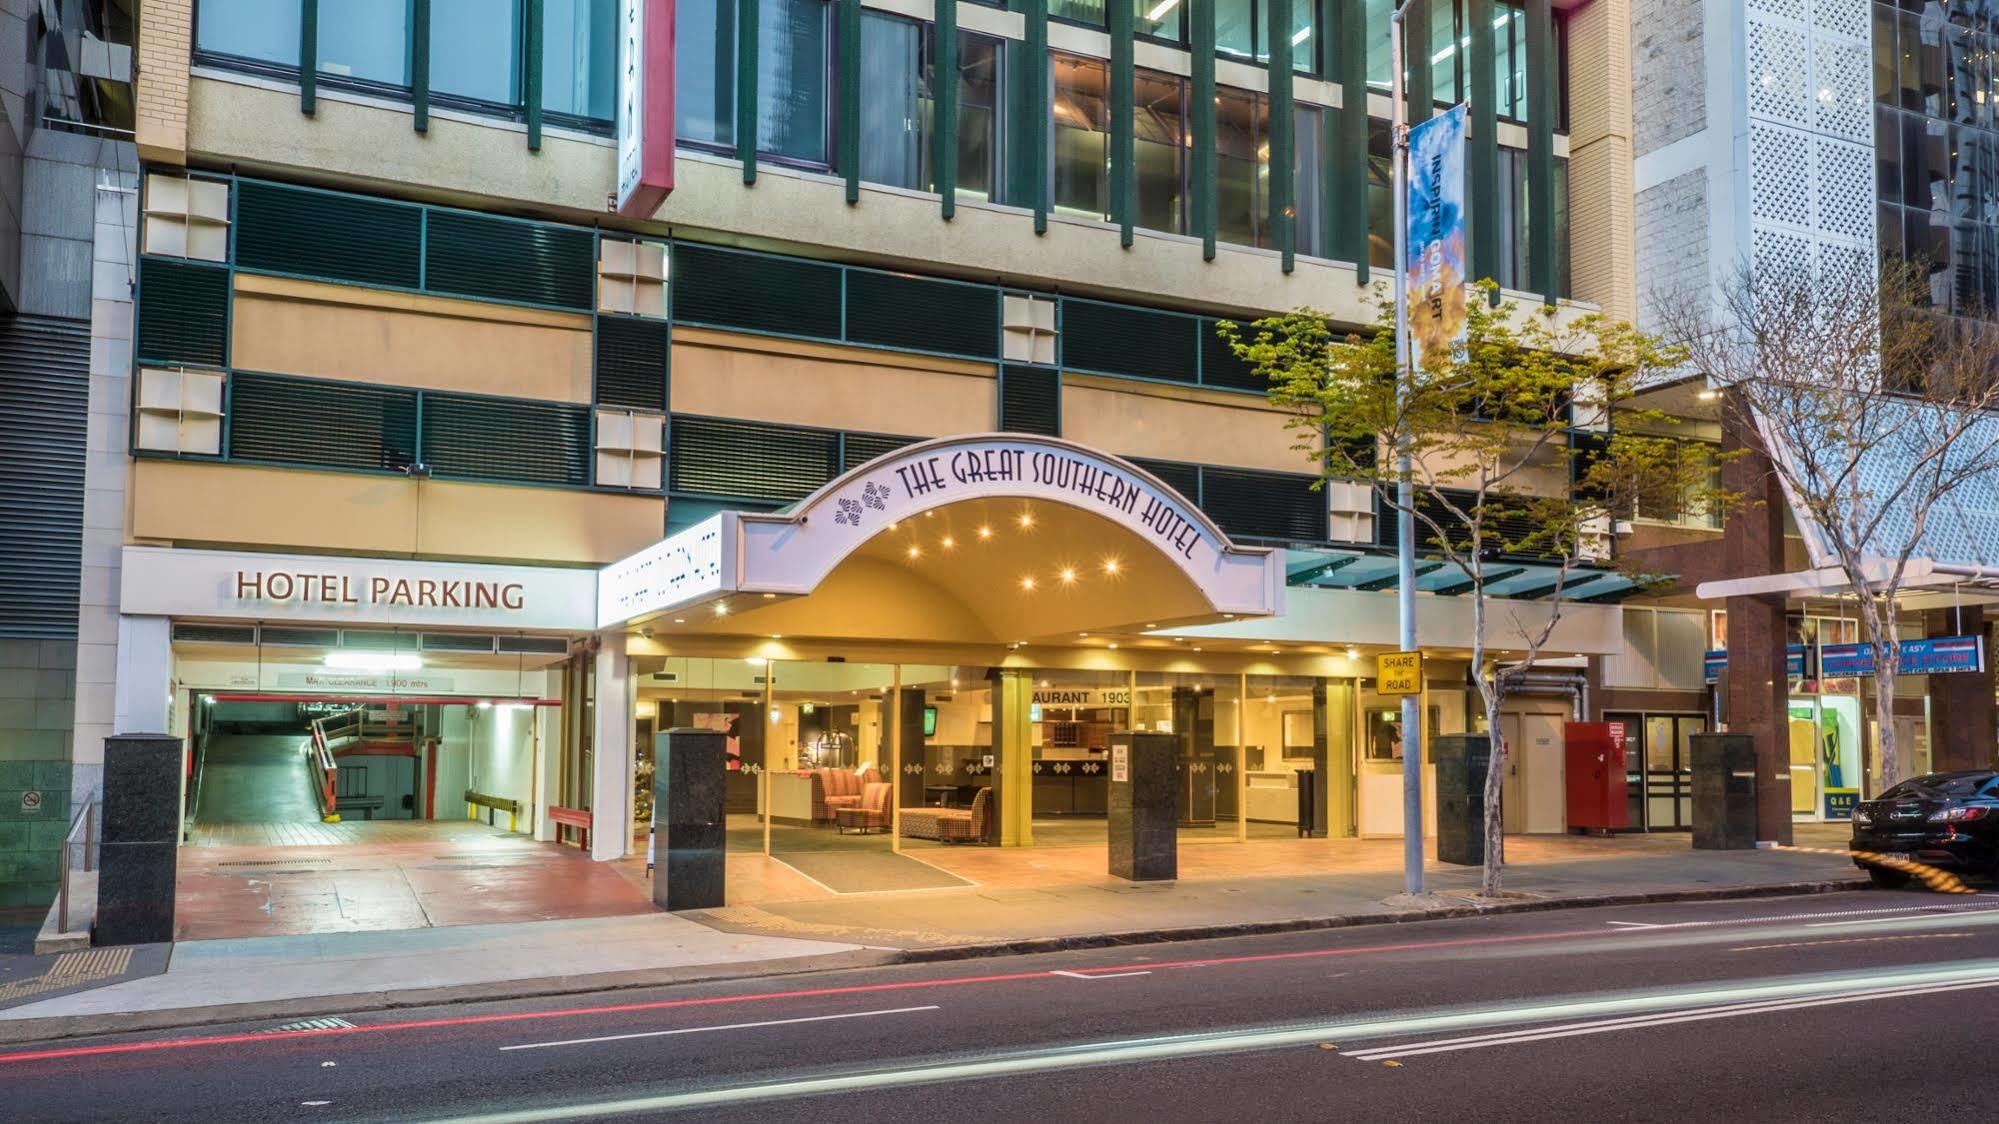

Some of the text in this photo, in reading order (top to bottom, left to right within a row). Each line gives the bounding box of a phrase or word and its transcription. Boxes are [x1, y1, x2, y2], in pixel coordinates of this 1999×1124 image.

[896, 450, 1201, 560] THE GREAT SOUTHERN HOTEL
[237, 571, 524, 610] HOTEL PARKING
[1384, 657, 1414, 668] SHARE
[1386, 680, 1411, 690] ROAD
[1032, 691, 1130, 704] AURANT 1903
